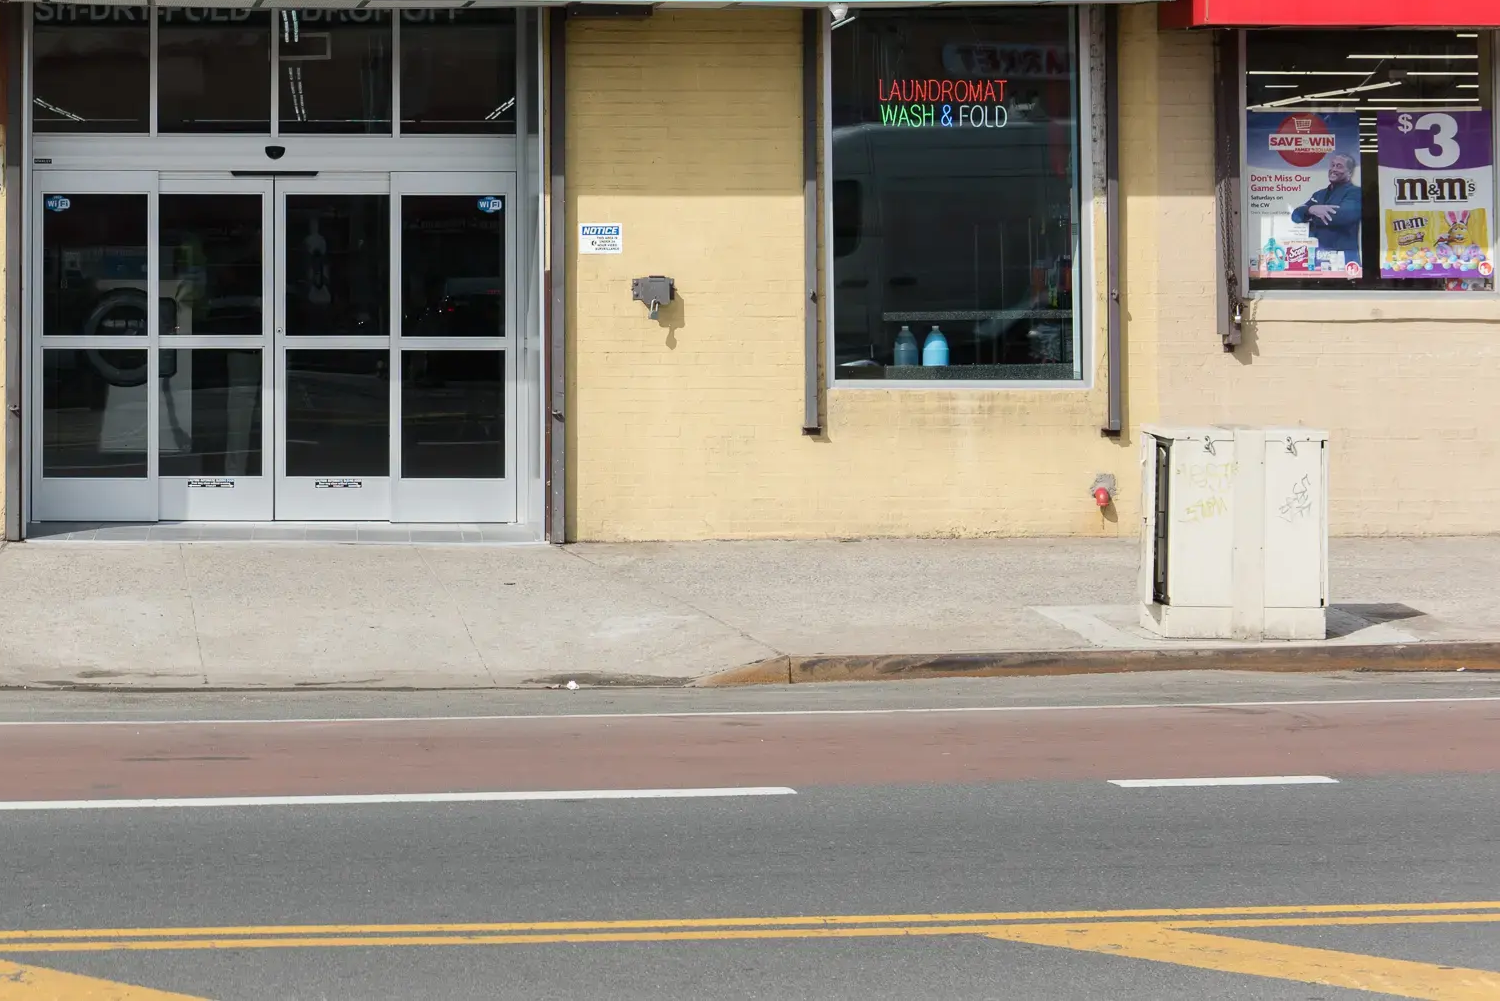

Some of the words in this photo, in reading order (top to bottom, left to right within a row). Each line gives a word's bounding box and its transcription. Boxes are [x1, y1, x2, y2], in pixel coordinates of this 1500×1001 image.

[878, 79, 1007, 103] LAUNDROMAT
[880, 104, 935, 128] WASH
[941, 104, 953, 128] &
[959, 104, 1008, 128] FOLD
[1270, 137, 1302, 146] SAVE
[1309, 137, 1335, 146] WIN
[1397, 112, 1461, 168] $3
[1250, 174, 1272, 182] Don't
[1274, 174, 1292, 182] Miss
[1294, 174, 1310, 182] Our
[1276, 184, 1301, 192] Show!
[583, 226, 619, 235] NOTICE
